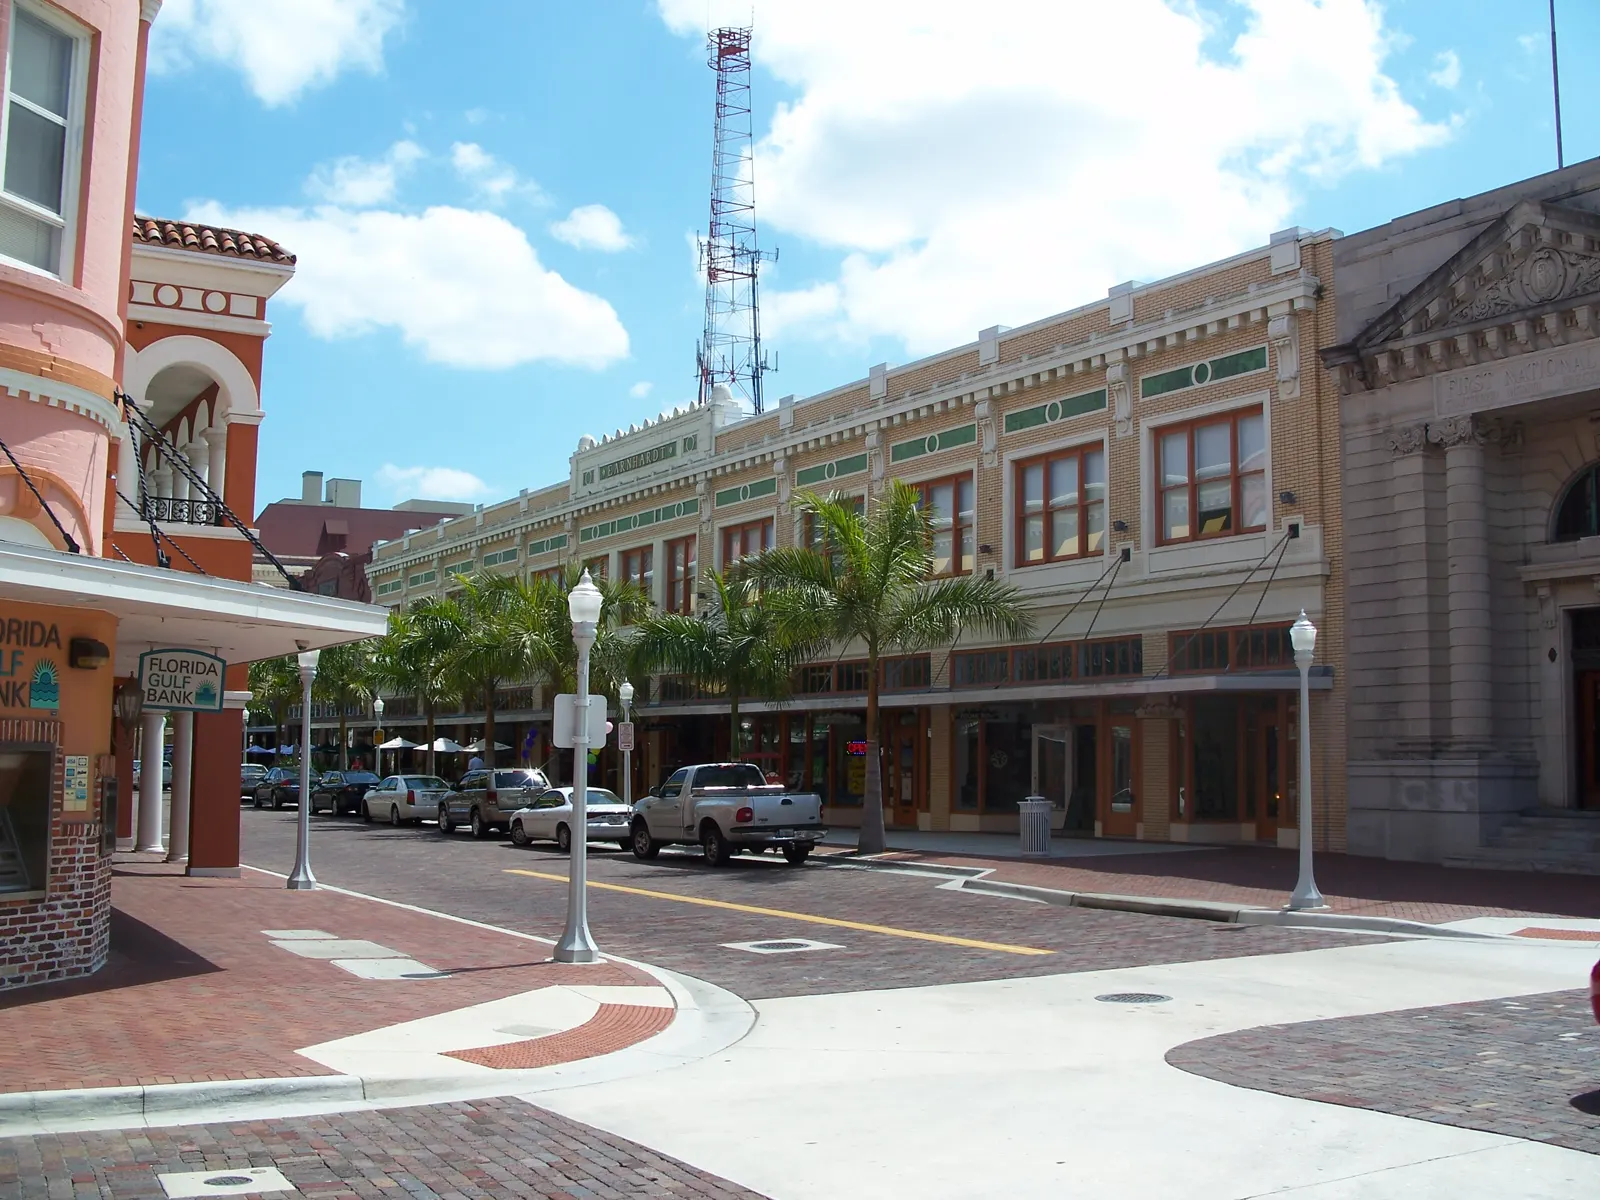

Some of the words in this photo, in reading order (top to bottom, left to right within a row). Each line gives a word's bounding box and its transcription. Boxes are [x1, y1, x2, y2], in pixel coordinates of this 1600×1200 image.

[1449, 371, 1494, 397] FIRST
[1505, 348, 1598, 387] NATIONAL
[607, 446, 666, 477] EARNHARDT
[149, 657, 219, 677] FLORIDA
[148, 672, 192, 690] GULF
[146, 688, 194, 705] BANK
